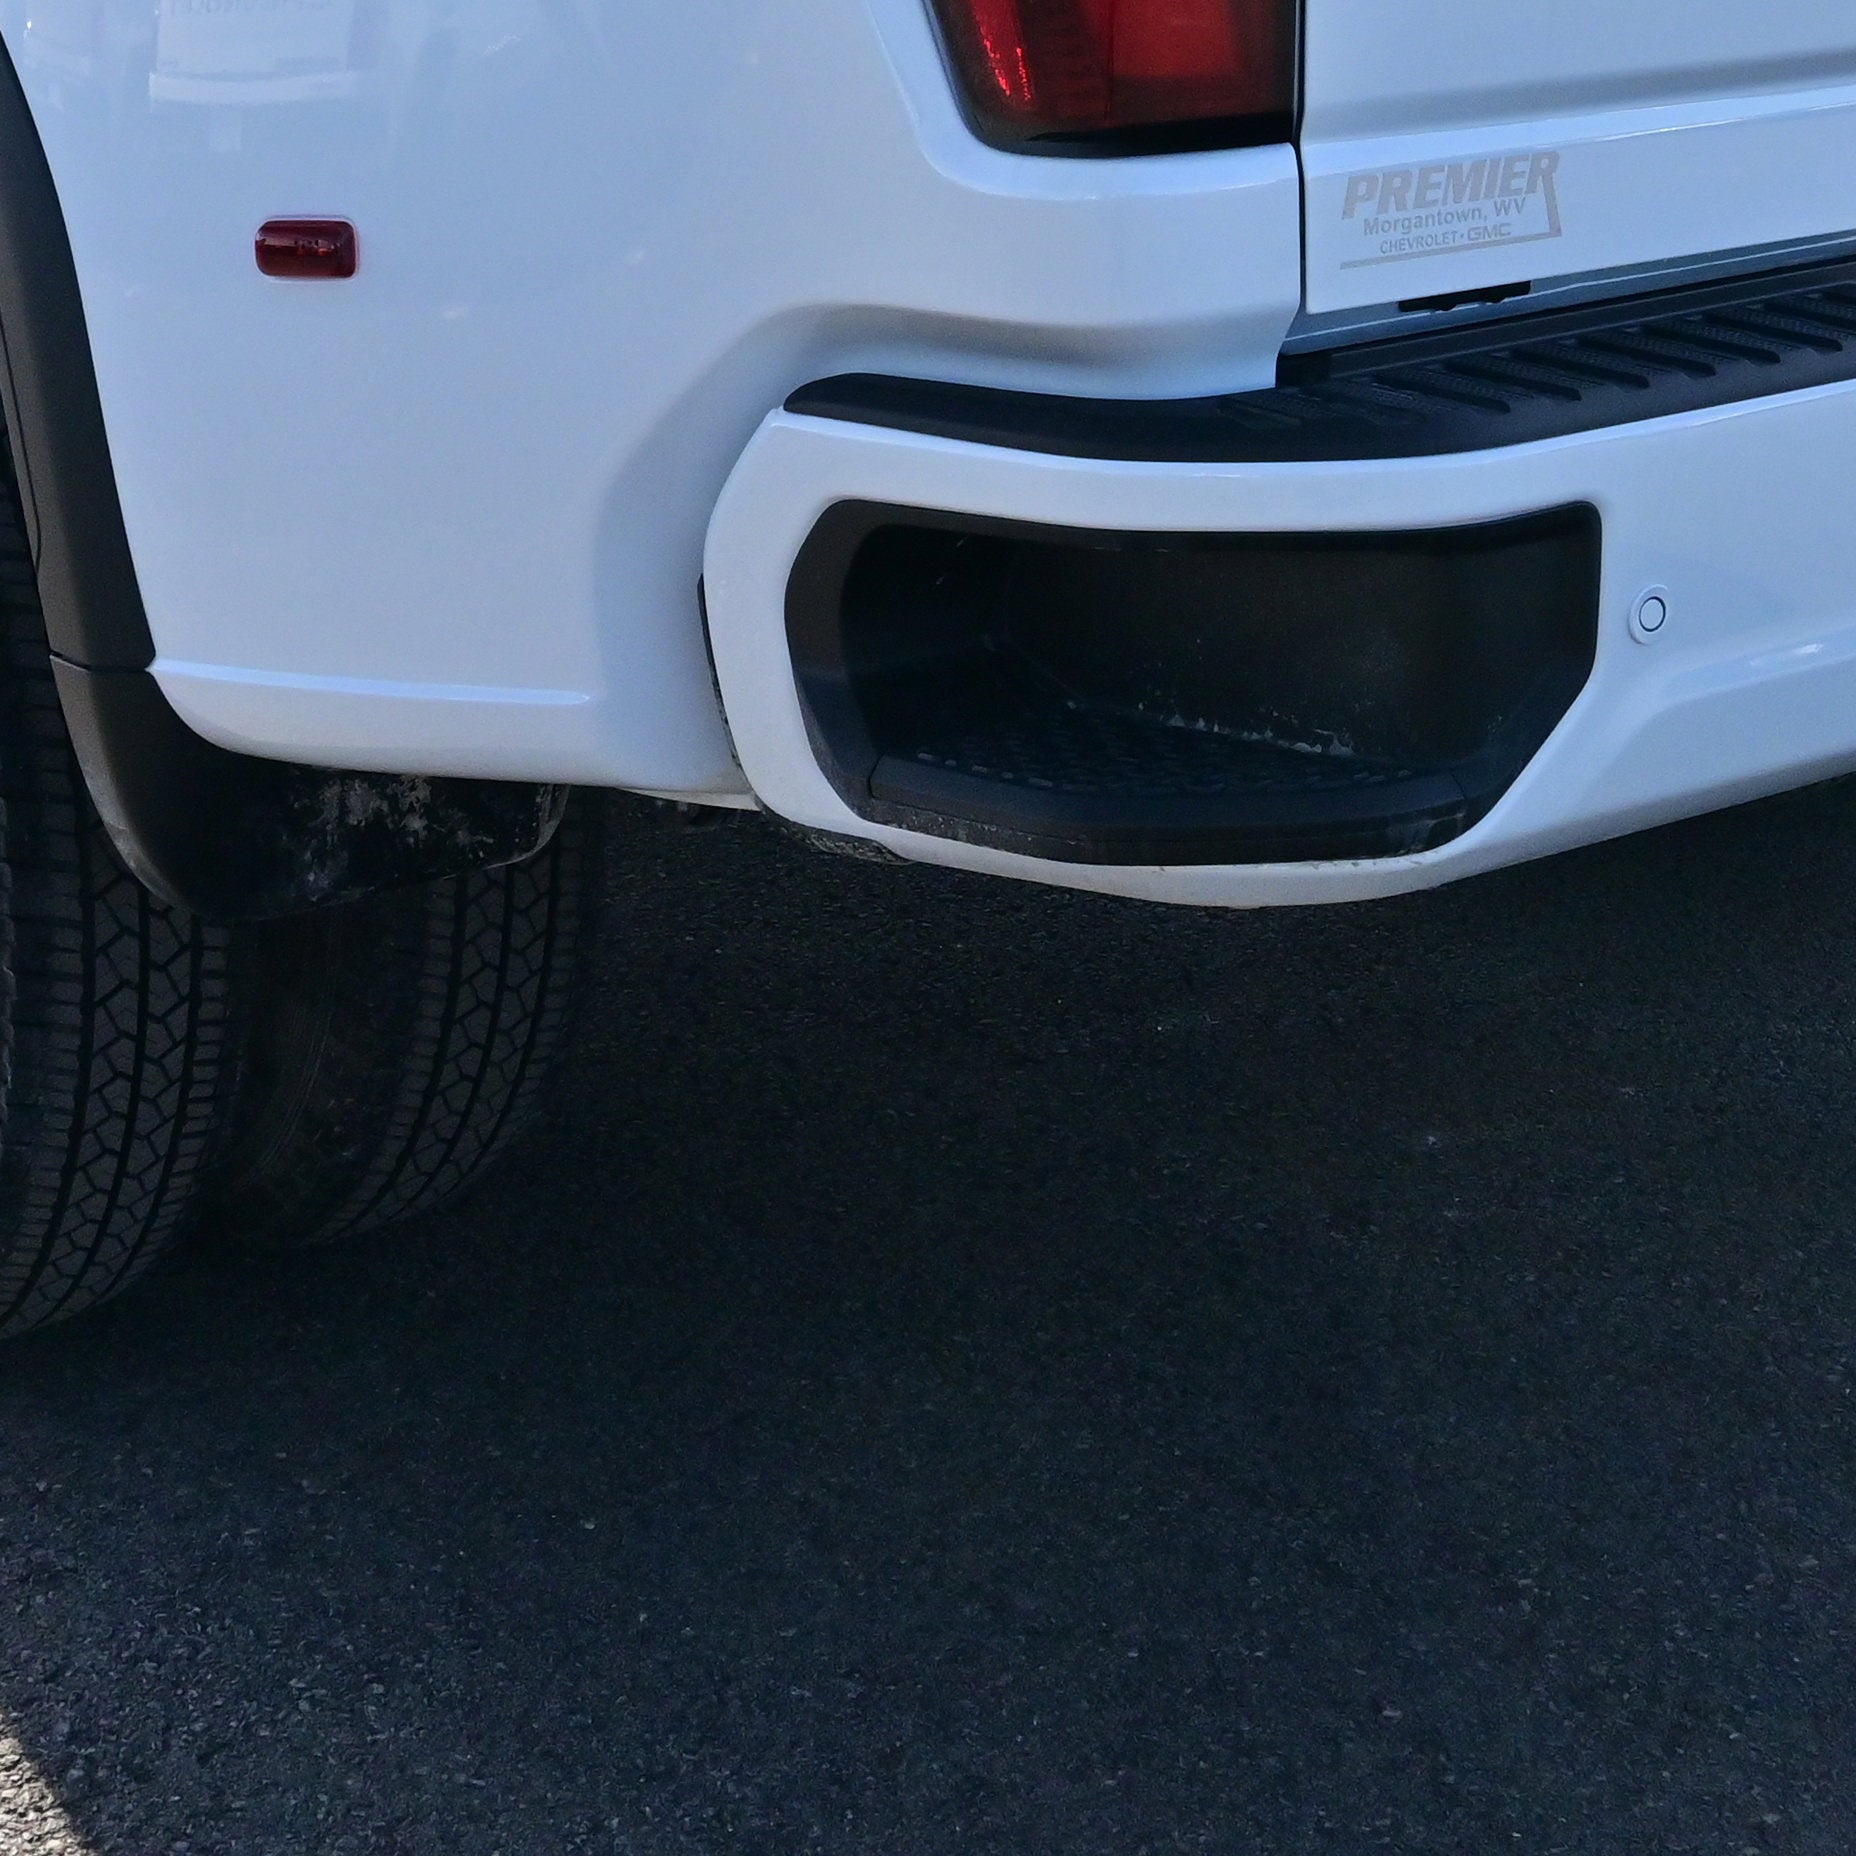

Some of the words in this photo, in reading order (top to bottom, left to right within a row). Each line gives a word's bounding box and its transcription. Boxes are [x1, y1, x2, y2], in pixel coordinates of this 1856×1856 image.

[1341, 150, 1560, 221] PREMIER
[1363, 206, 1488, 237] Morgantown,
[1494, 196, 1527, 217] WV
[1467, 222, 1512, 242] GMC
